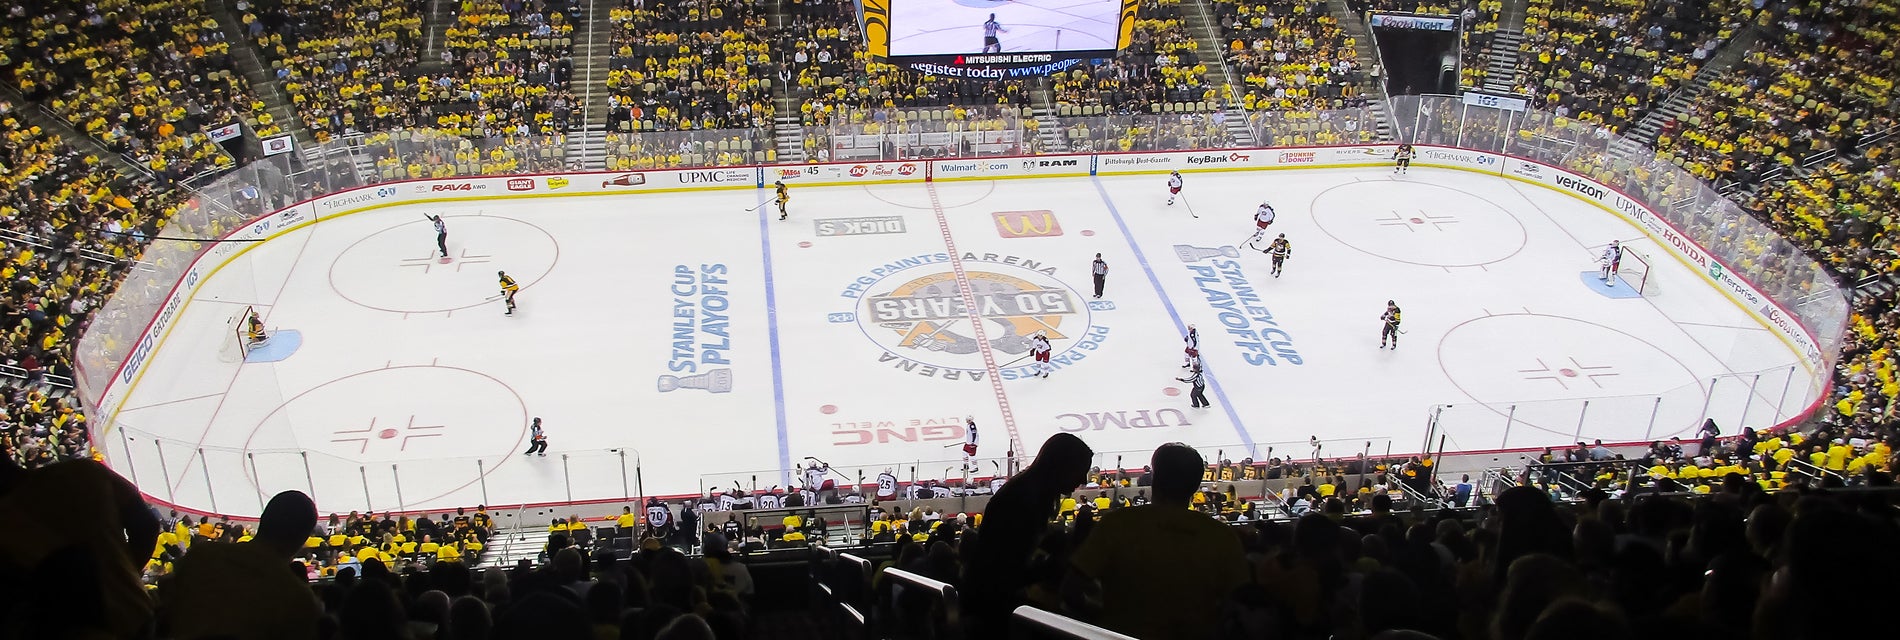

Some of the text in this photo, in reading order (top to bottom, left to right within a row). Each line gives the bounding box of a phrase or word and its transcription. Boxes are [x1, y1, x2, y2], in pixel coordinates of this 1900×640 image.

[1415, 21, 1444, 30] LIGHT
[965, 54, 1052, 64] MITSUBISHI ELECTRIC
[966, 65, 1007, 81] today
[1478, 94, 1498, 106] IGS
[211, 126, 235, 139] FedEx
[901, 165, 914, 173] DQ
[941, 162, 977, 172] Walmart
[1039, 159, 1077, 167] RAM
[1105, 158, 1135, 166] Pittsburgh
[1187, 155, 1228, 164] KeyBank
[678, 171, 725, 184] UPMC
[852, 167, 866, 175] DQ
[431, 183, 472, 191] RAV4
[1556, 174, 1603, 200] verizon
[1615, 195, 1648, 224] UPMC
[1663, 228, 1707, 269] HONDA
[187, 267, 199, 290] IGS
[841, 252, 1058, 298] PPG PAINTS ARENA
[1711, 262, 1758, 305] enterprise
[153, 292, 181, 338] GATORADE
[700, 263, 730, 365] PLAYOFFS
[875, 293, 1068, 320] 50 YEARS
[1186, 265, 1277, 366] PLAYOFFS
[1211, 259, 1304, 366] STANLEY CUP
[668, 264, 697, 373] STANLEY CUP
[1770, 309, 1791, 334] Coors
[1077, 325, 1110, 351] PPG
[1791, 329, 1807, 348] LIGHT
[123, 333, 153, 384] GEICO
[878, 351, 986, 381] ARENA
[831, 417, 960, 429] LIVE WELL
[1055, 408, 1193, 433] UPMC
[831, 425, 966, 446] GNC
[880, 479, 891, 490] 25
[721, 500, 732, 511] 13
[650, 511, 663, 521] 70
